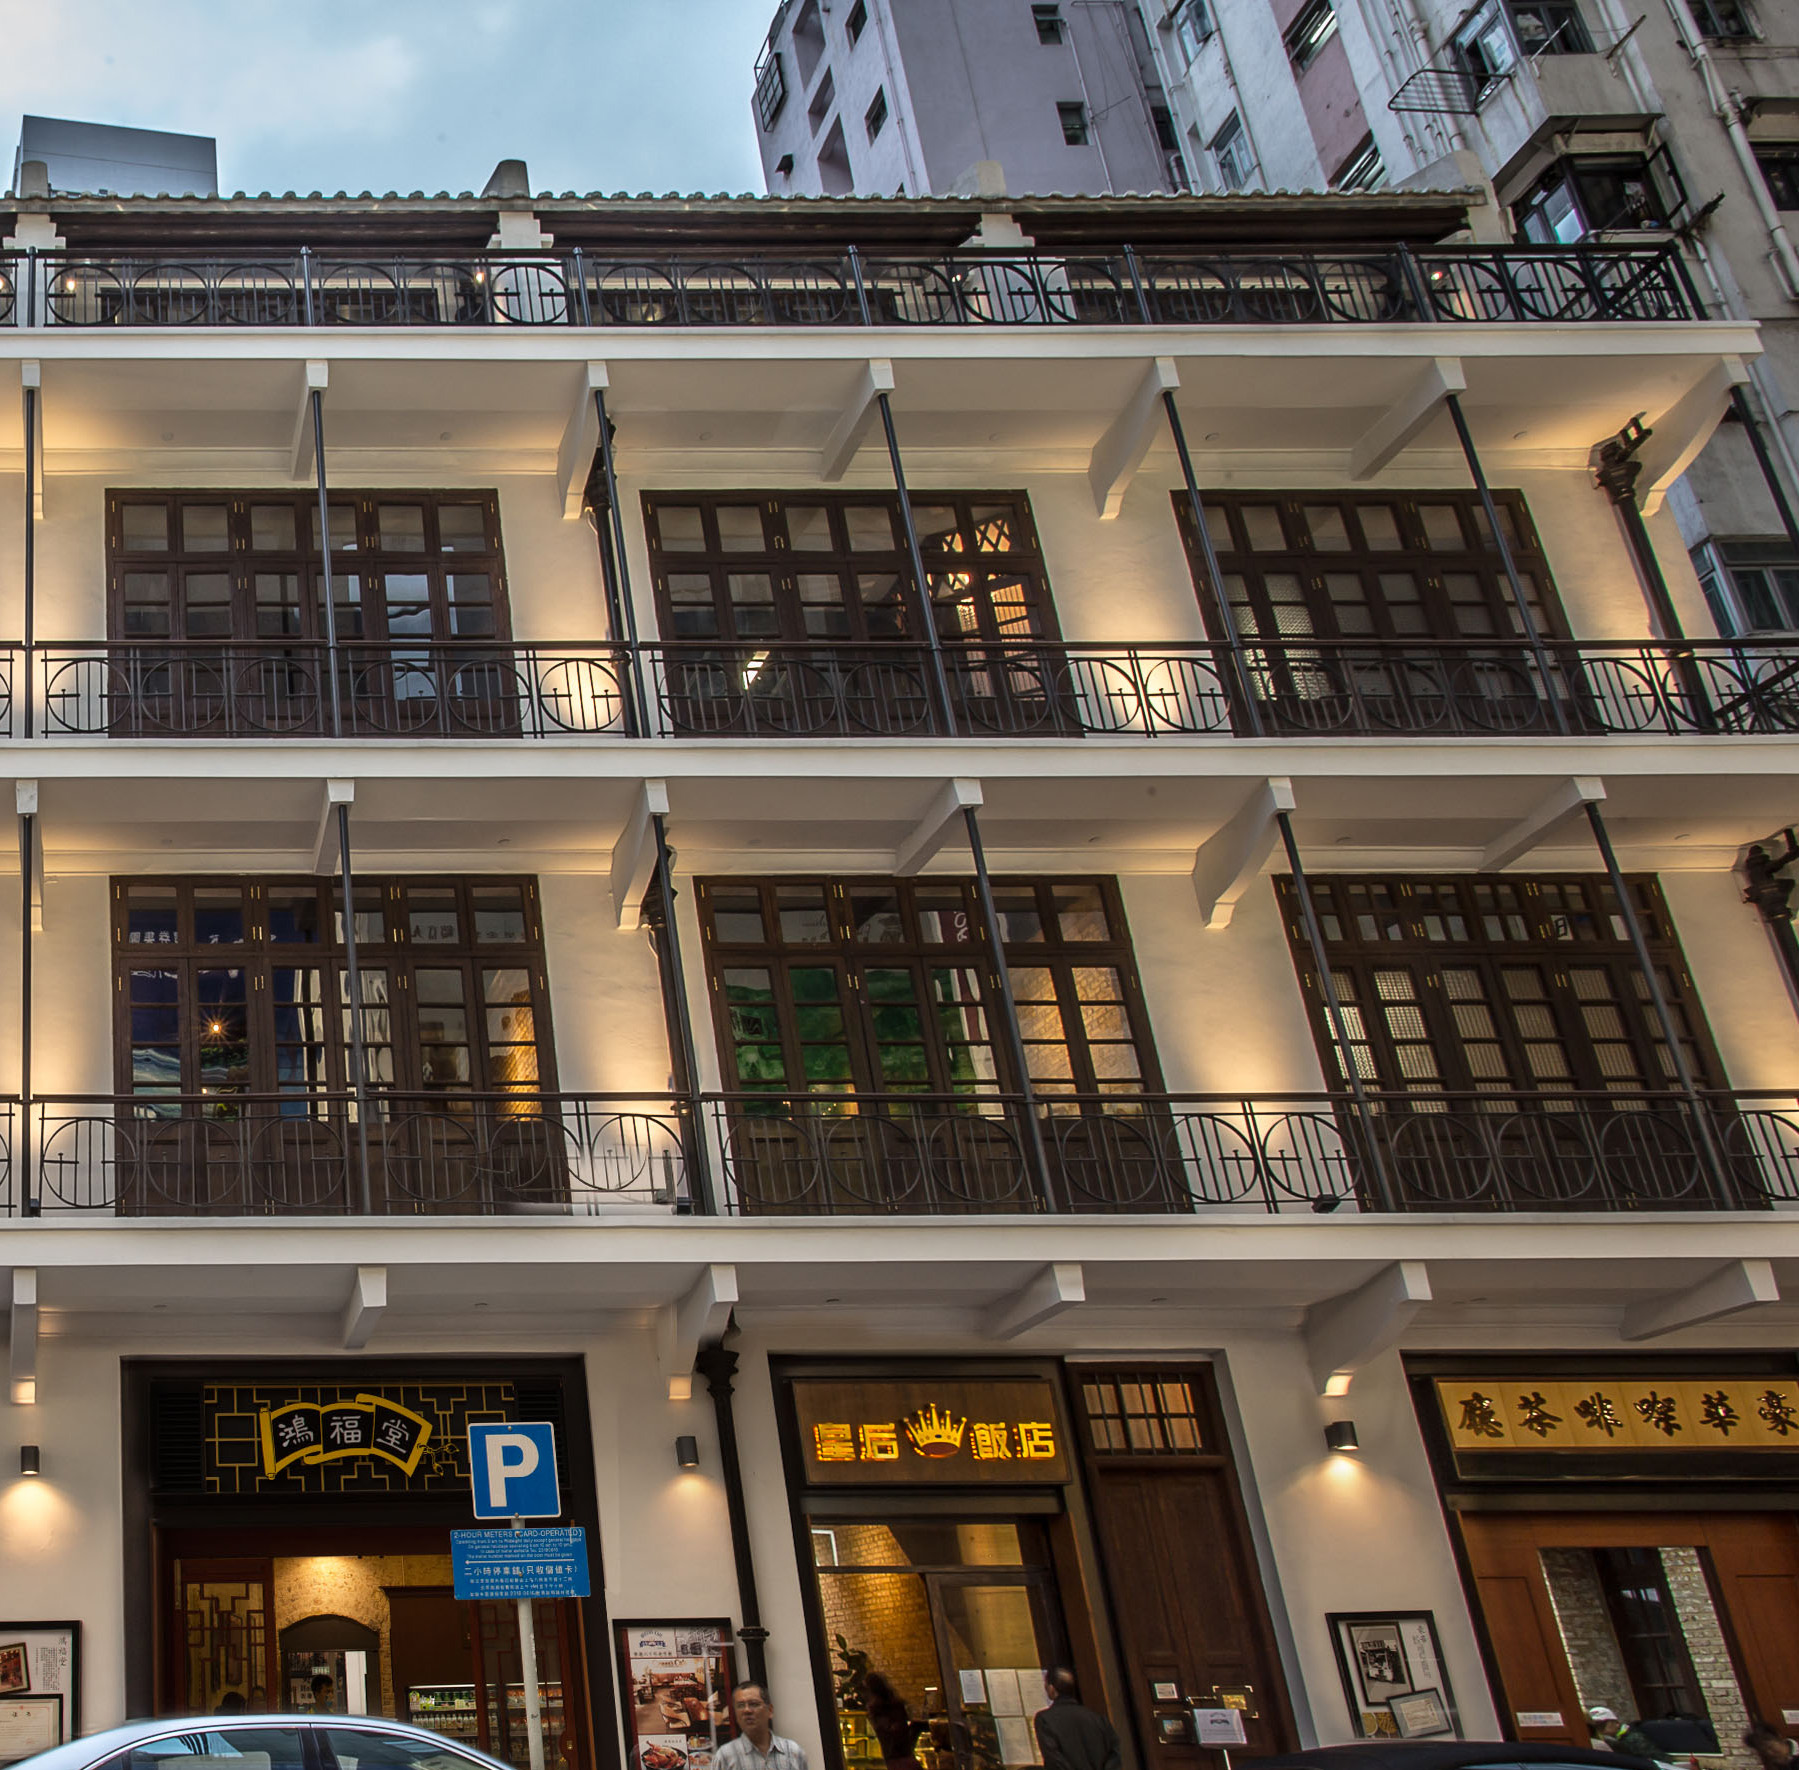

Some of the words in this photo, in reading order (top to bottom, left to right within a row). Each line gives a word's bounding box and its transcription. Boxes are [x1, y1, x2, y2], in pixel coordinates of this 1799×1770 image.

[278, 1414, 407, 1454] 鴻福堂
[813, 1422, 901, 1462] 皇后
[969, 1421, 1056, 1461] 飯店
[485, 1433, 540, 1507] P
[454, 1531, 482, 1539] 2-HOUR
[483, 1530, 513, 1538] METERS
